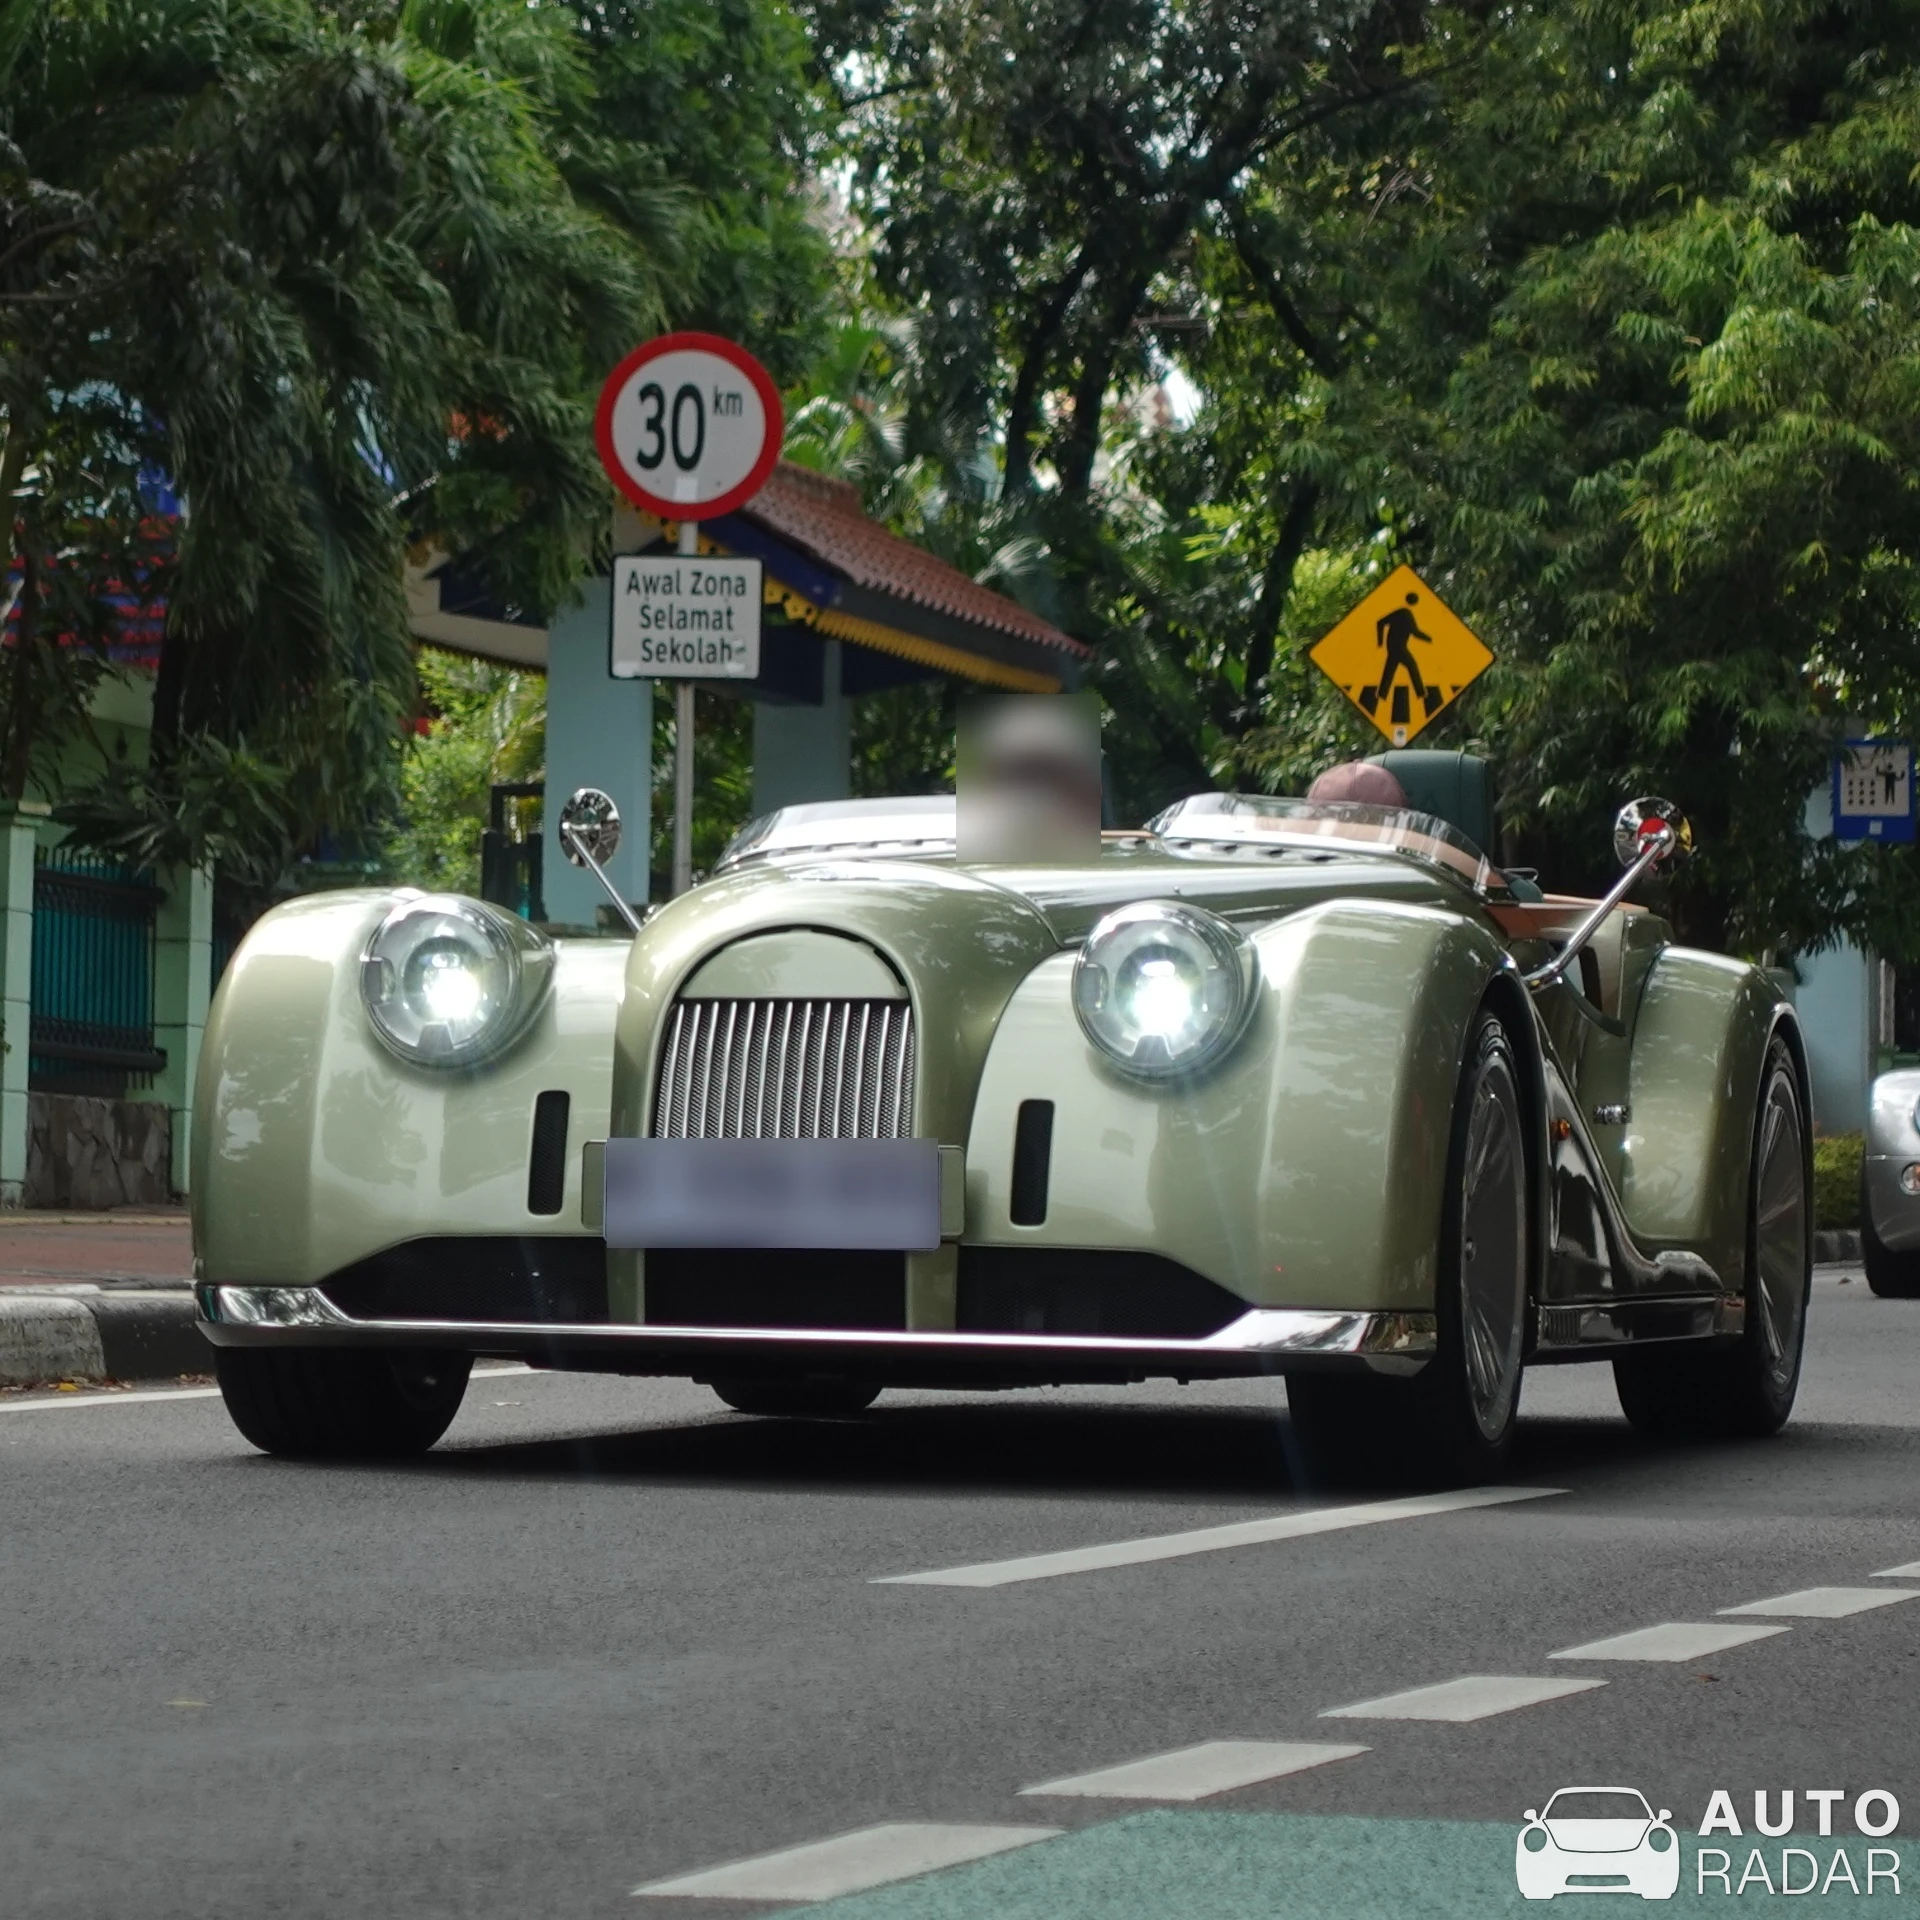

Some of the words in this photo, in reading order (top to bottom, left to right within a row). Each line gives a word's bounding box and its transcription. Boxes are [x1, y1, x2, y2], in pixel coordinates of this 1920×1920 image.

[636, 381, 706, 472] 30
[713, 384, 744, 417] km
[626, 568, 681, 596] Awal
[690, 571, 747, 597] Zona
[639, 603, 734, 631] Selamat
[641, 636, 733, 664] Sekolah
